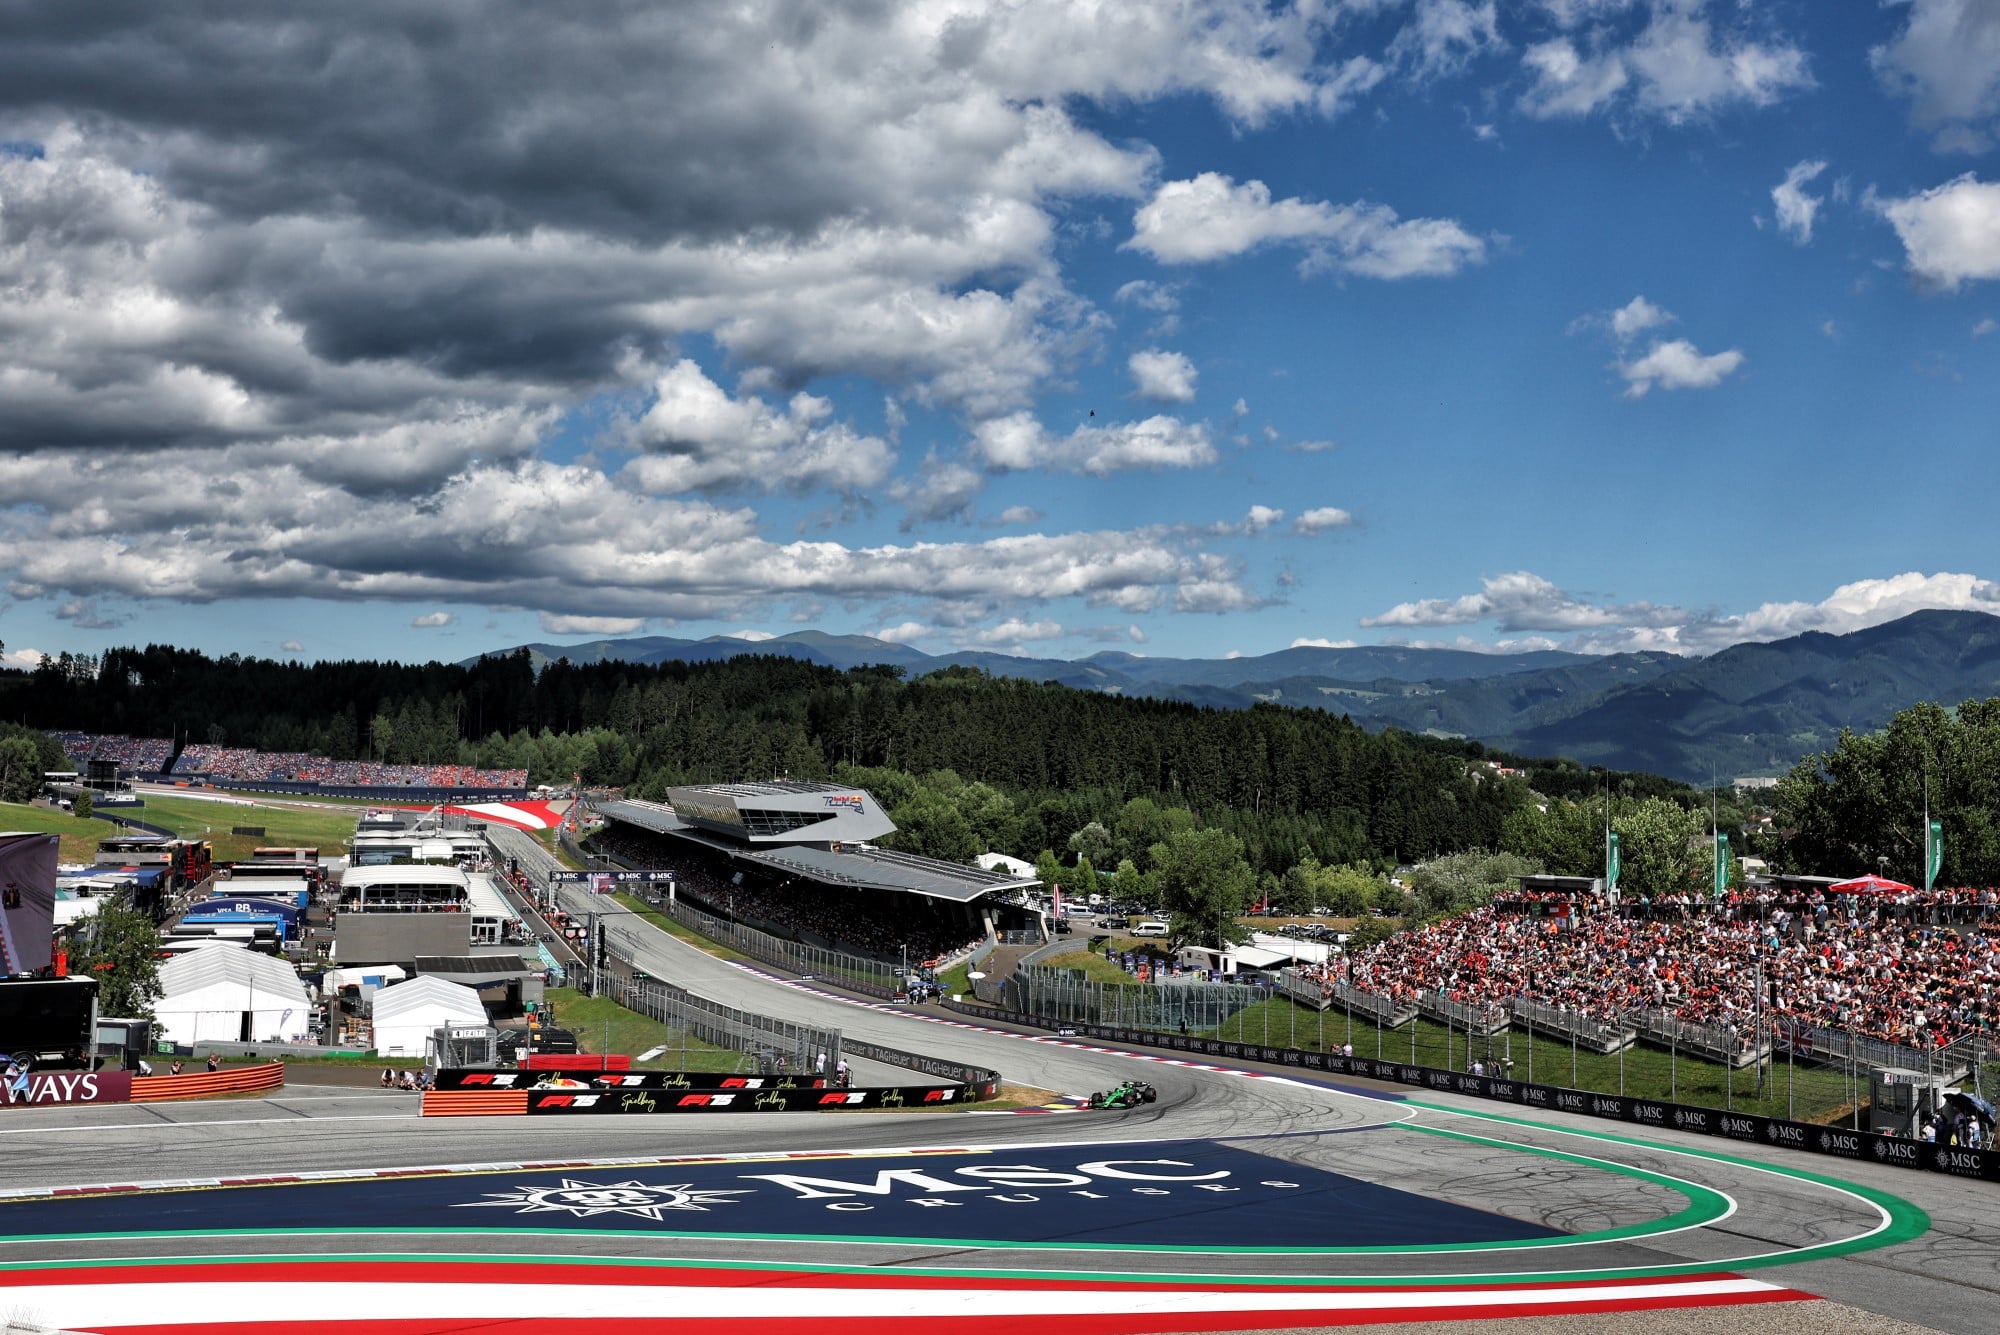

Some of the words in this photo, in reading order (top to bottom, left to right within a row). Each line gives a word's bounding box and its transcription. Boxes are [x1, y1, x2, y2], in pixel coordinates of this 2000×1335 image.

[840, 1040, 866, 1055] AGHeuer
[921, 1059, 964, 1078] TAGHeuer
[1332, 1058, 1344, 1068] MSC
[1356, 1061, 1368, 1071] MSC
[1381, 1065, 1394, 1075] MSC
[1407, 1069, 1420, 1080] MSC
[662, 1074, 692, 1090] Spielberg
[1436, 1074, 1450, 1084] MSC
[1465, 1078, 1480, 1089] MSC
[1496, 1084, 1512, 1095] MSC
[1529, 1088, 1546, 1100] MSC
[536, 1095, 575, 1107] F1
[622, 1092, 656, 1112] Spielberg
[676, 1095, 712, 1106] F1
[755, 1091, 787, 1110] Spielberg
[818, 1092, 848, 1104] F1
[881, 1089, 904, 1108] Spielberg
[1565, 1094, 1583, 1107] MSC
[1602, 1100, 1620, 1112] MSC
[1642, 1106, 1662, 1119] MSC
[1685, 1112, 1706, 1125] MSC
[1731, 1118, 1754, 1132] MSC
[1780, 1126, 1804, 1140] MSC
[1832, 1134, 1858, 1150] MSC
[1888, 1142, 1916, 1158] MSC
[1951, 1152, 1980, 1168] MSC
[737, 1159, 1231, 1199] MSC
[826, 1180, 1300, 1211] CRUISES
